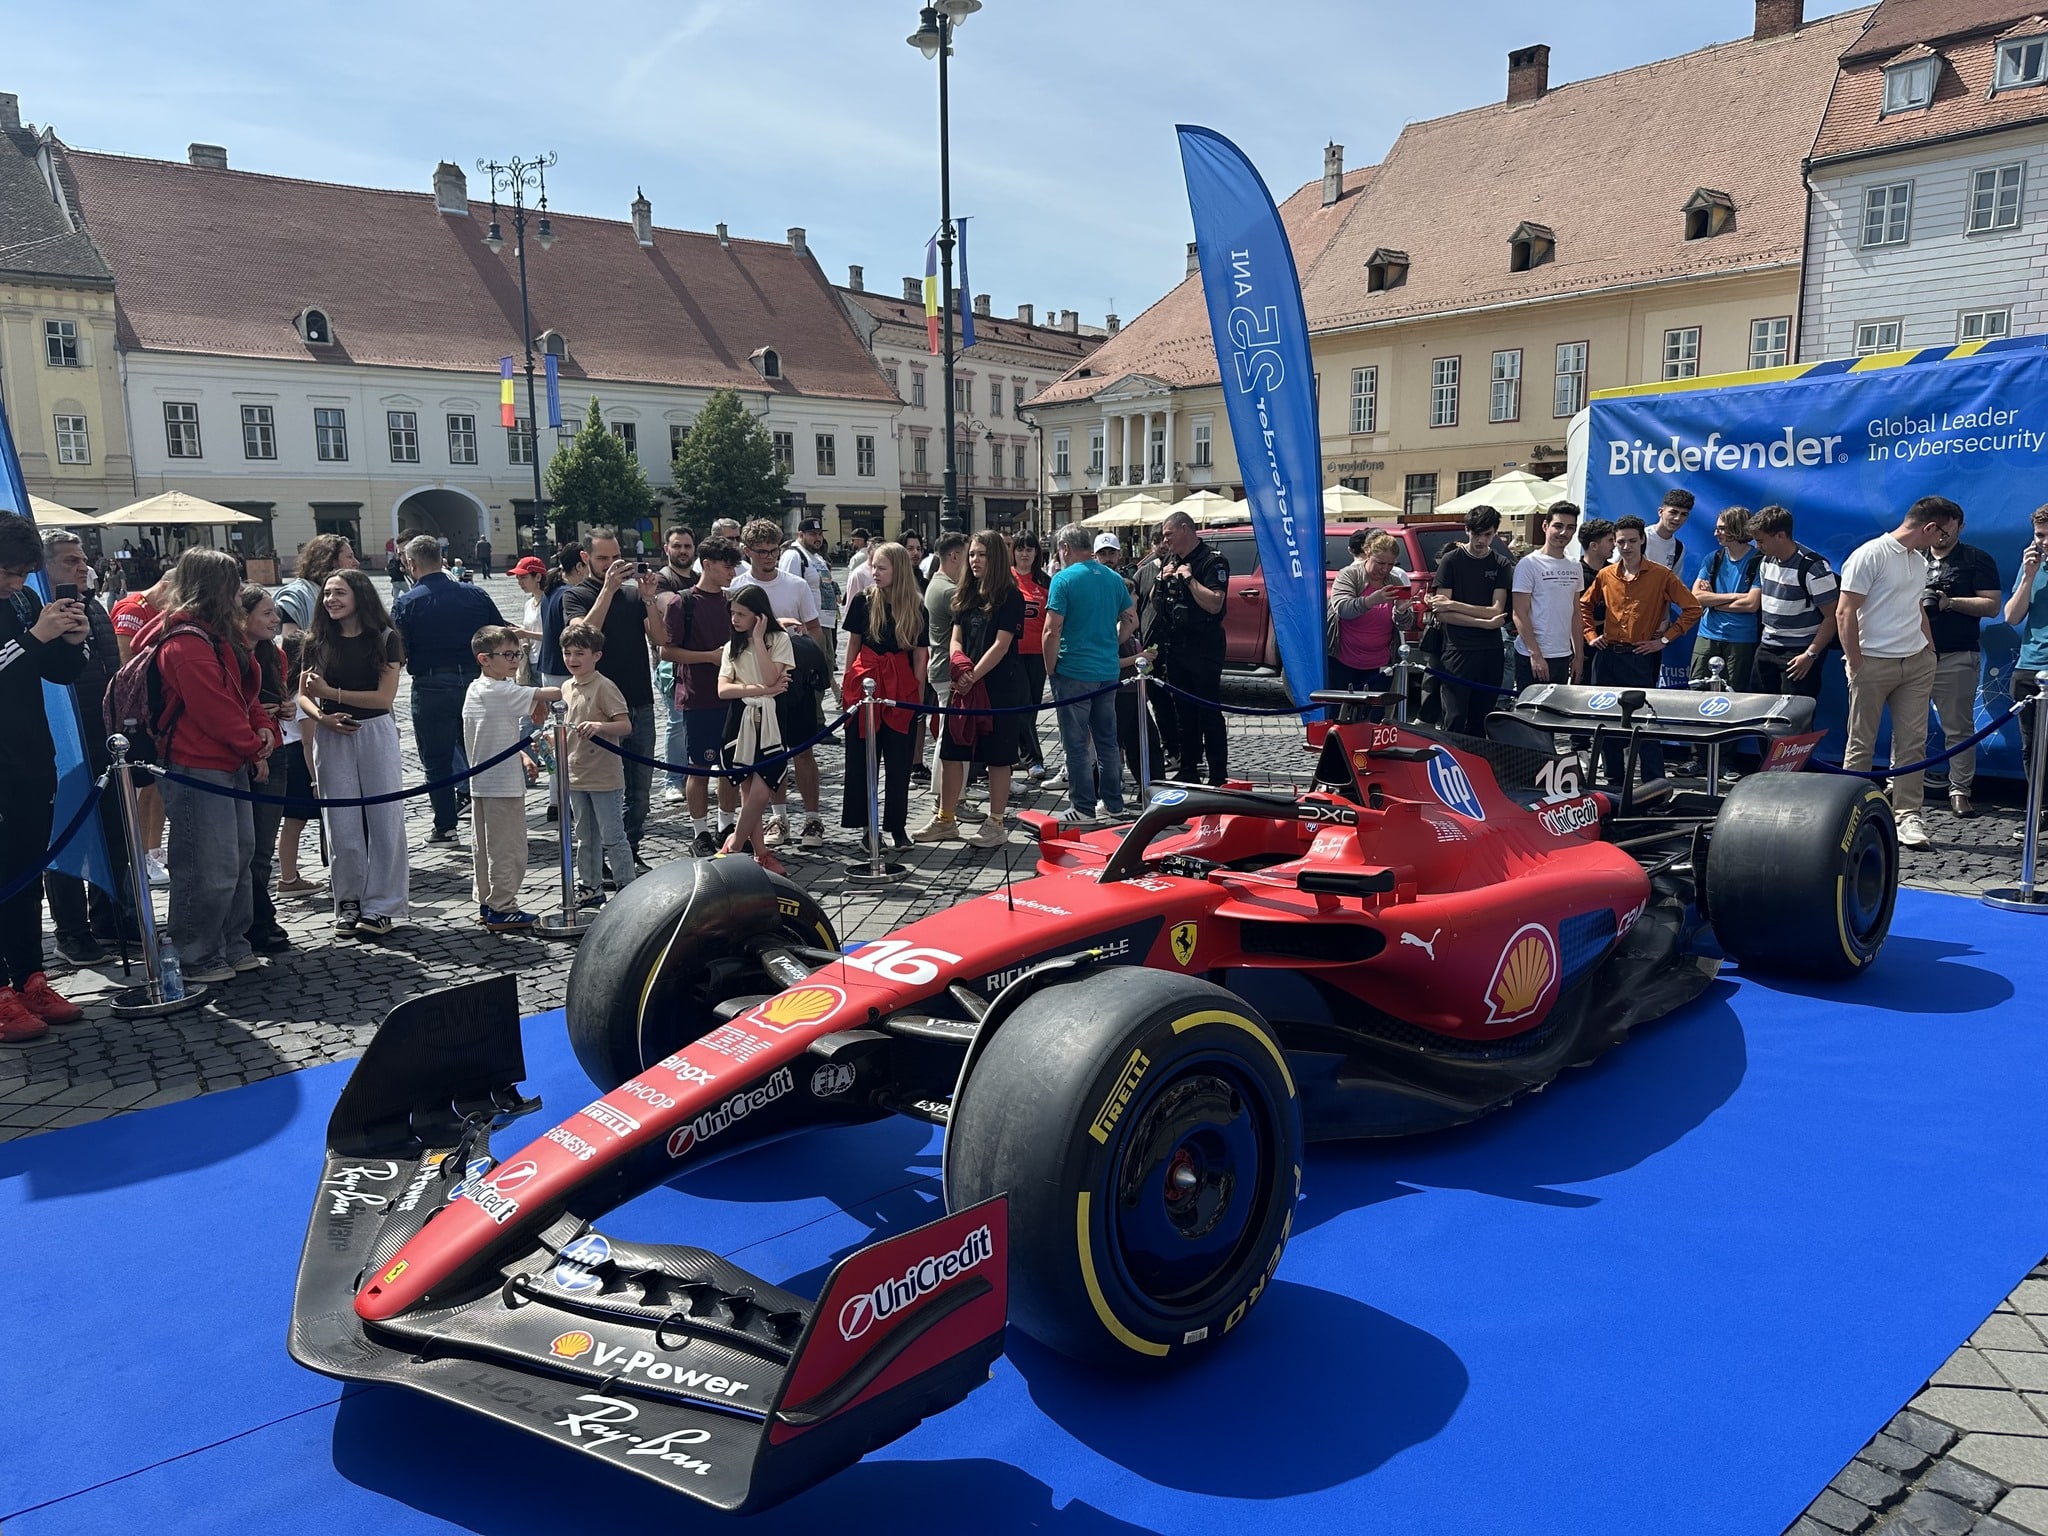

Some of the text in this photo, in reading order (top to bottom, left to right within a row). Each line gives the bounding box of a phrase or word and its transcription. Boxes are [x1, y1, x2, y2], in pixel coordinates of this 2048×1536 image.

[1867, 406, 2019, 438] Global Leader
[1868, 428, 2046, 462] In Cybersecurity
[1337, 460, 1385, 473] vodafone
[1588, 692, 1618, 710] hp
[1699, 696, 1731, 716] hp
[1373, 726, 1398, 746] ZCG
[1429, 747, 1485, 821] hp
[1535, 755, 1581, 804] 16
[1298, 805, 1357, 824] DXC
[1549, 798, 1599, 836] UniCredit
[835, 939, 963, 986] 16
[698, 1025, 773, 1064] IBM
[620, 1079, 677, 1109] WHOOP
[694, 1067, 796, 1142] UniCredit
[1088, 1048, 1150, 1145] PIRELLI
[578, 1100, 641, 1138] PIRELLI
[875, 1225, 993, 1320] UniCredit
[593, 1340, 749, 1400] V-Power
